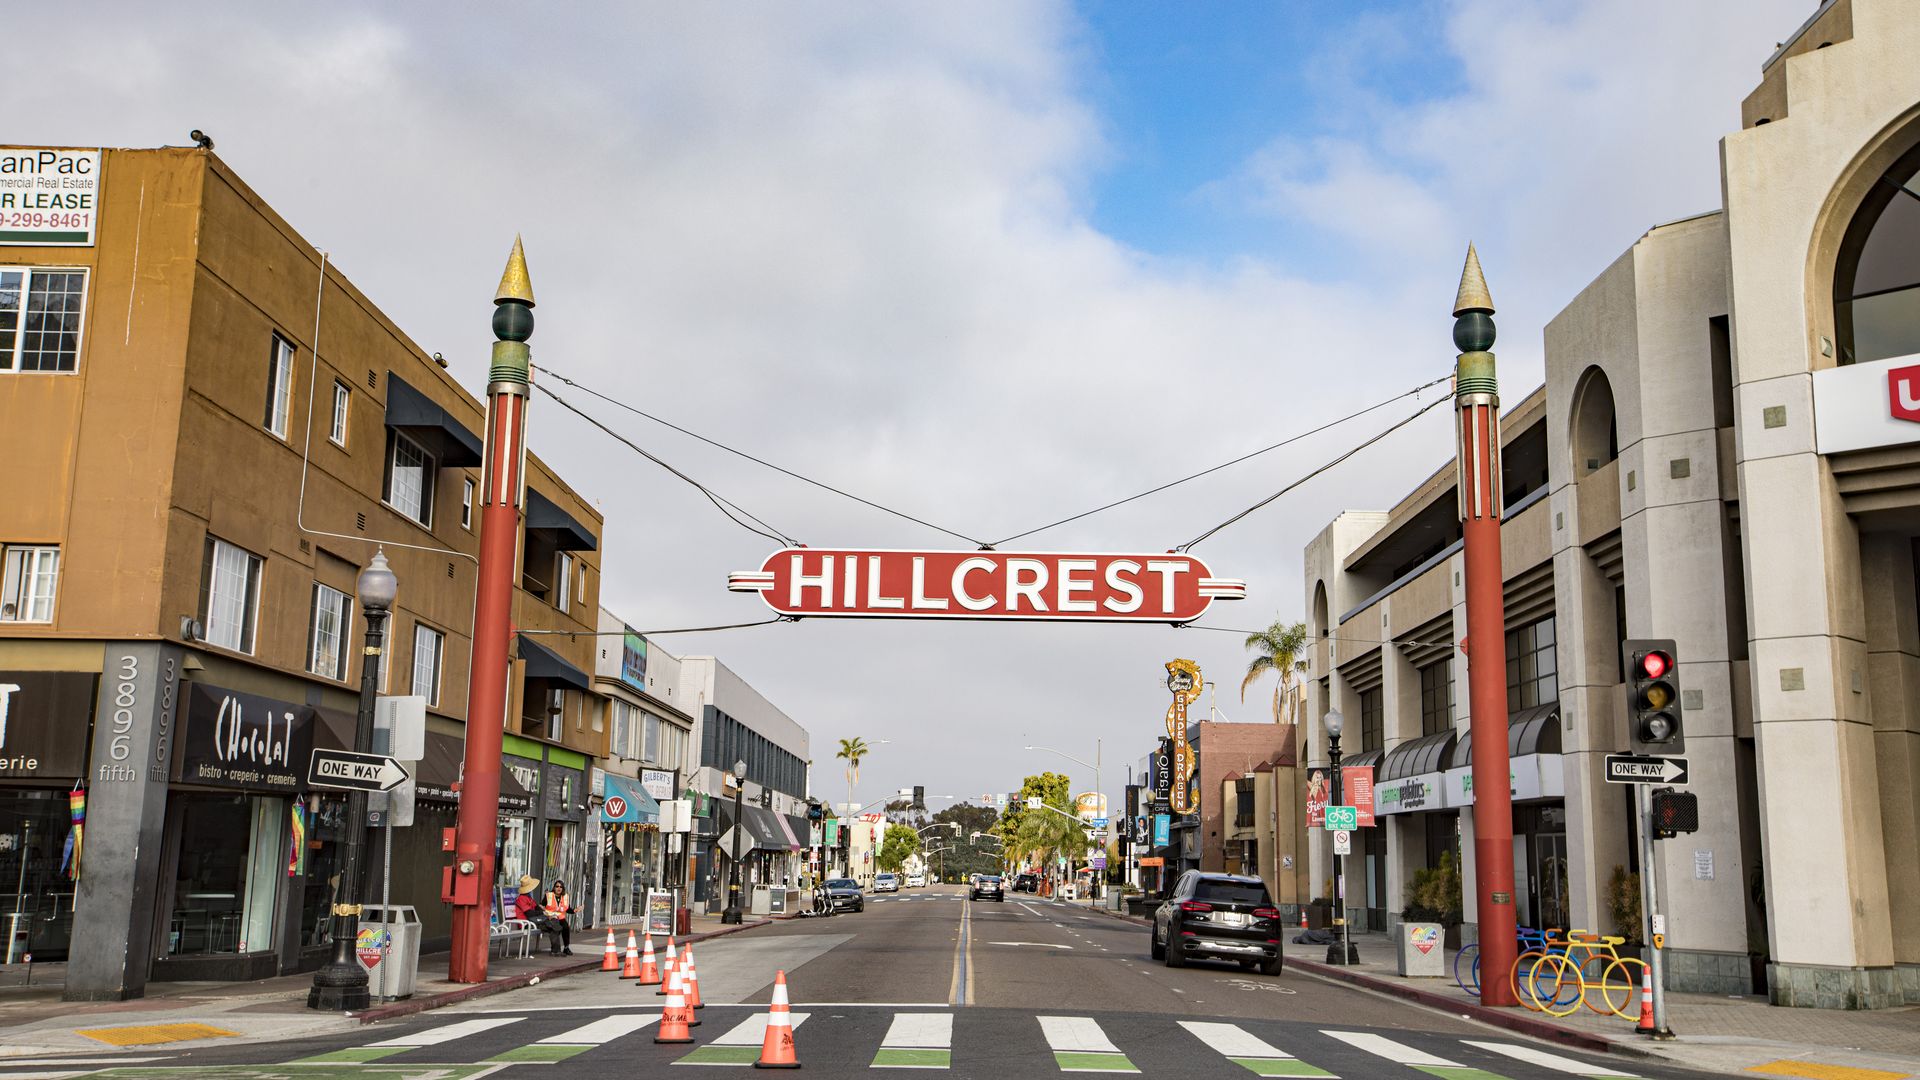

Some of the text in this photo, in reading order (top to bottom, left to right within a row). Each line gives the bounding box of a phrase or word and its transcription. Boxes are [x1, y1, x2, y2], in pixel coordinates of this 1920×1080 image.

[37, 177, 59, 188] Real
[62, 177, 93, 189] Estate
[22, 193, 92, 209] LEASE
[789, 554, 1191, 614] HILLCREST
[110, 656, 138, 760] 3896
[156, 658, 174, 761] 3896
[1176, 694, 1185, 809] GOLDEN DRAGON
[99, 764, 136, 780] fifth
[151, 765, 168, 781] fifth
[199, 764, 297, 786] bistro creperie cremerie
[322, 761, 382, 780] ONE WAY
[1615, 764, 1664, 775] ONE WAY
[643, 771, 671, 785] GILBERT'S
[609, 801, 624, 815] W
